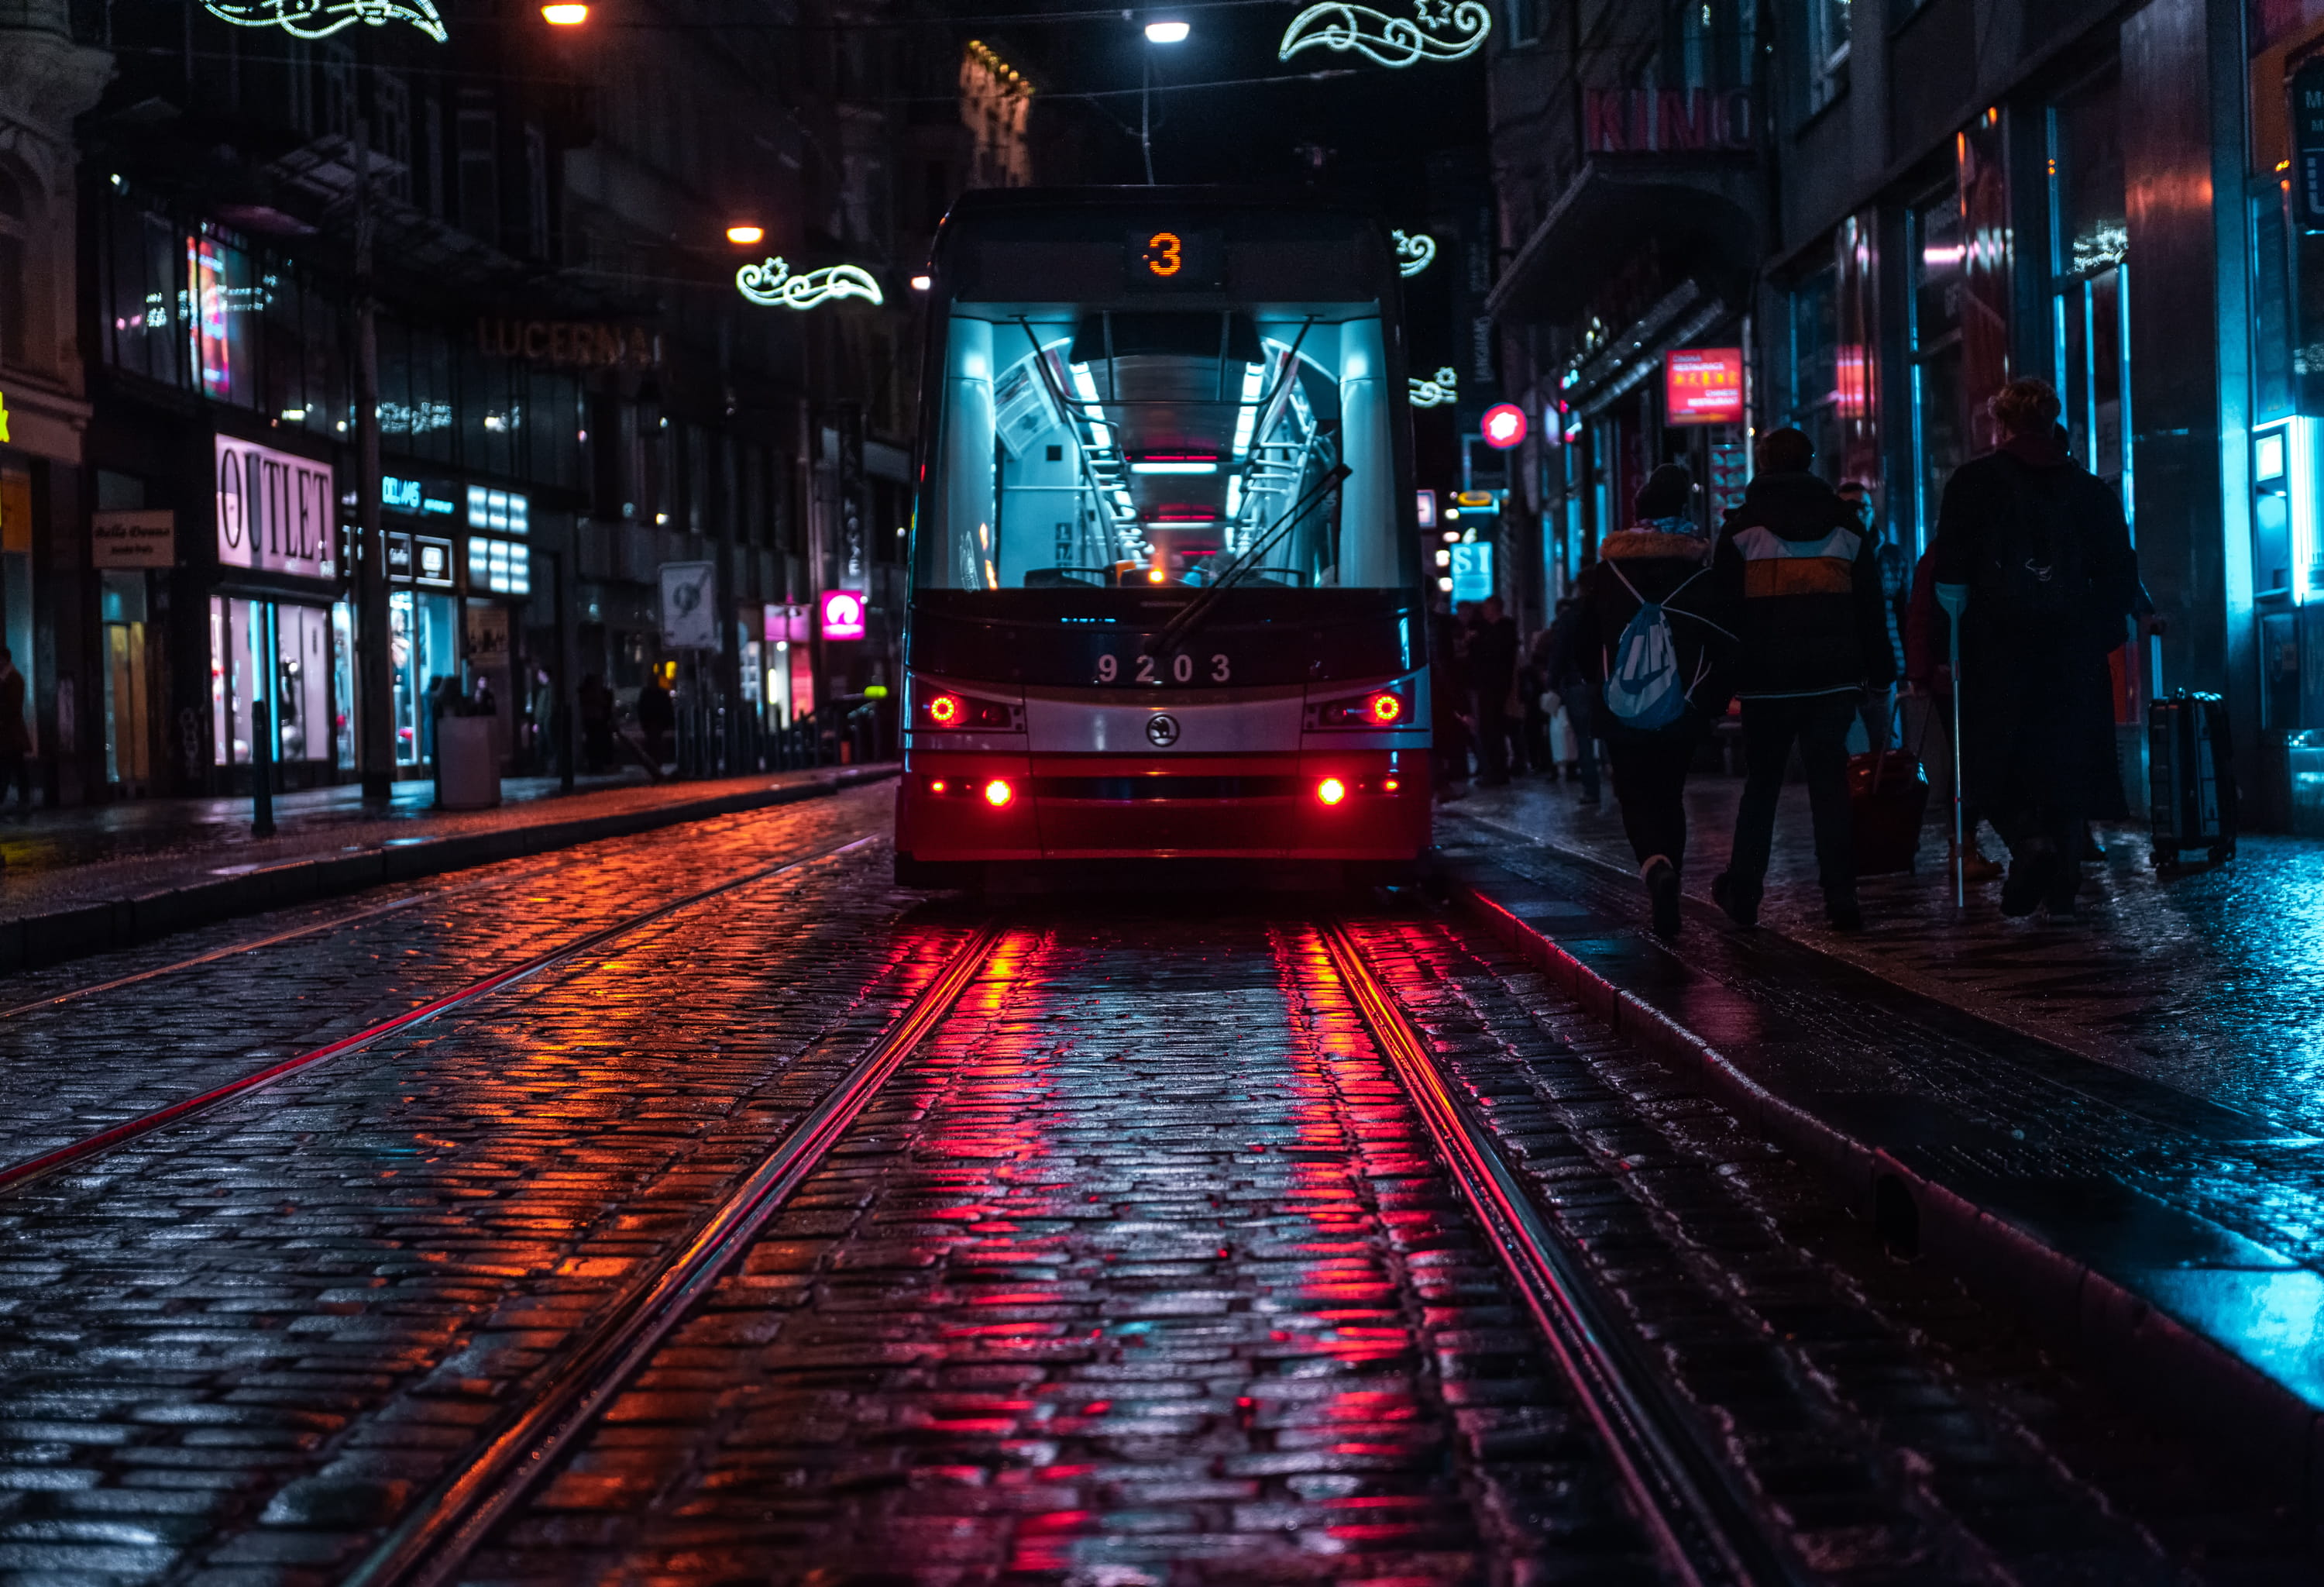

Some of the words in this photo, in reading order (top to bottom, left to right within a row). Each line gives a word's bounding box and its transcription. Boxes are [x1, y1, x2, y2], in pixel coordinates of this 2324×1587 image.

[1149, 232, 1181, 276] 3
[477, 315, 653, 367] LUCERNA
[221, 448, 330, 563] OUTLET
[1098, 653, 1231, 683] 9203
